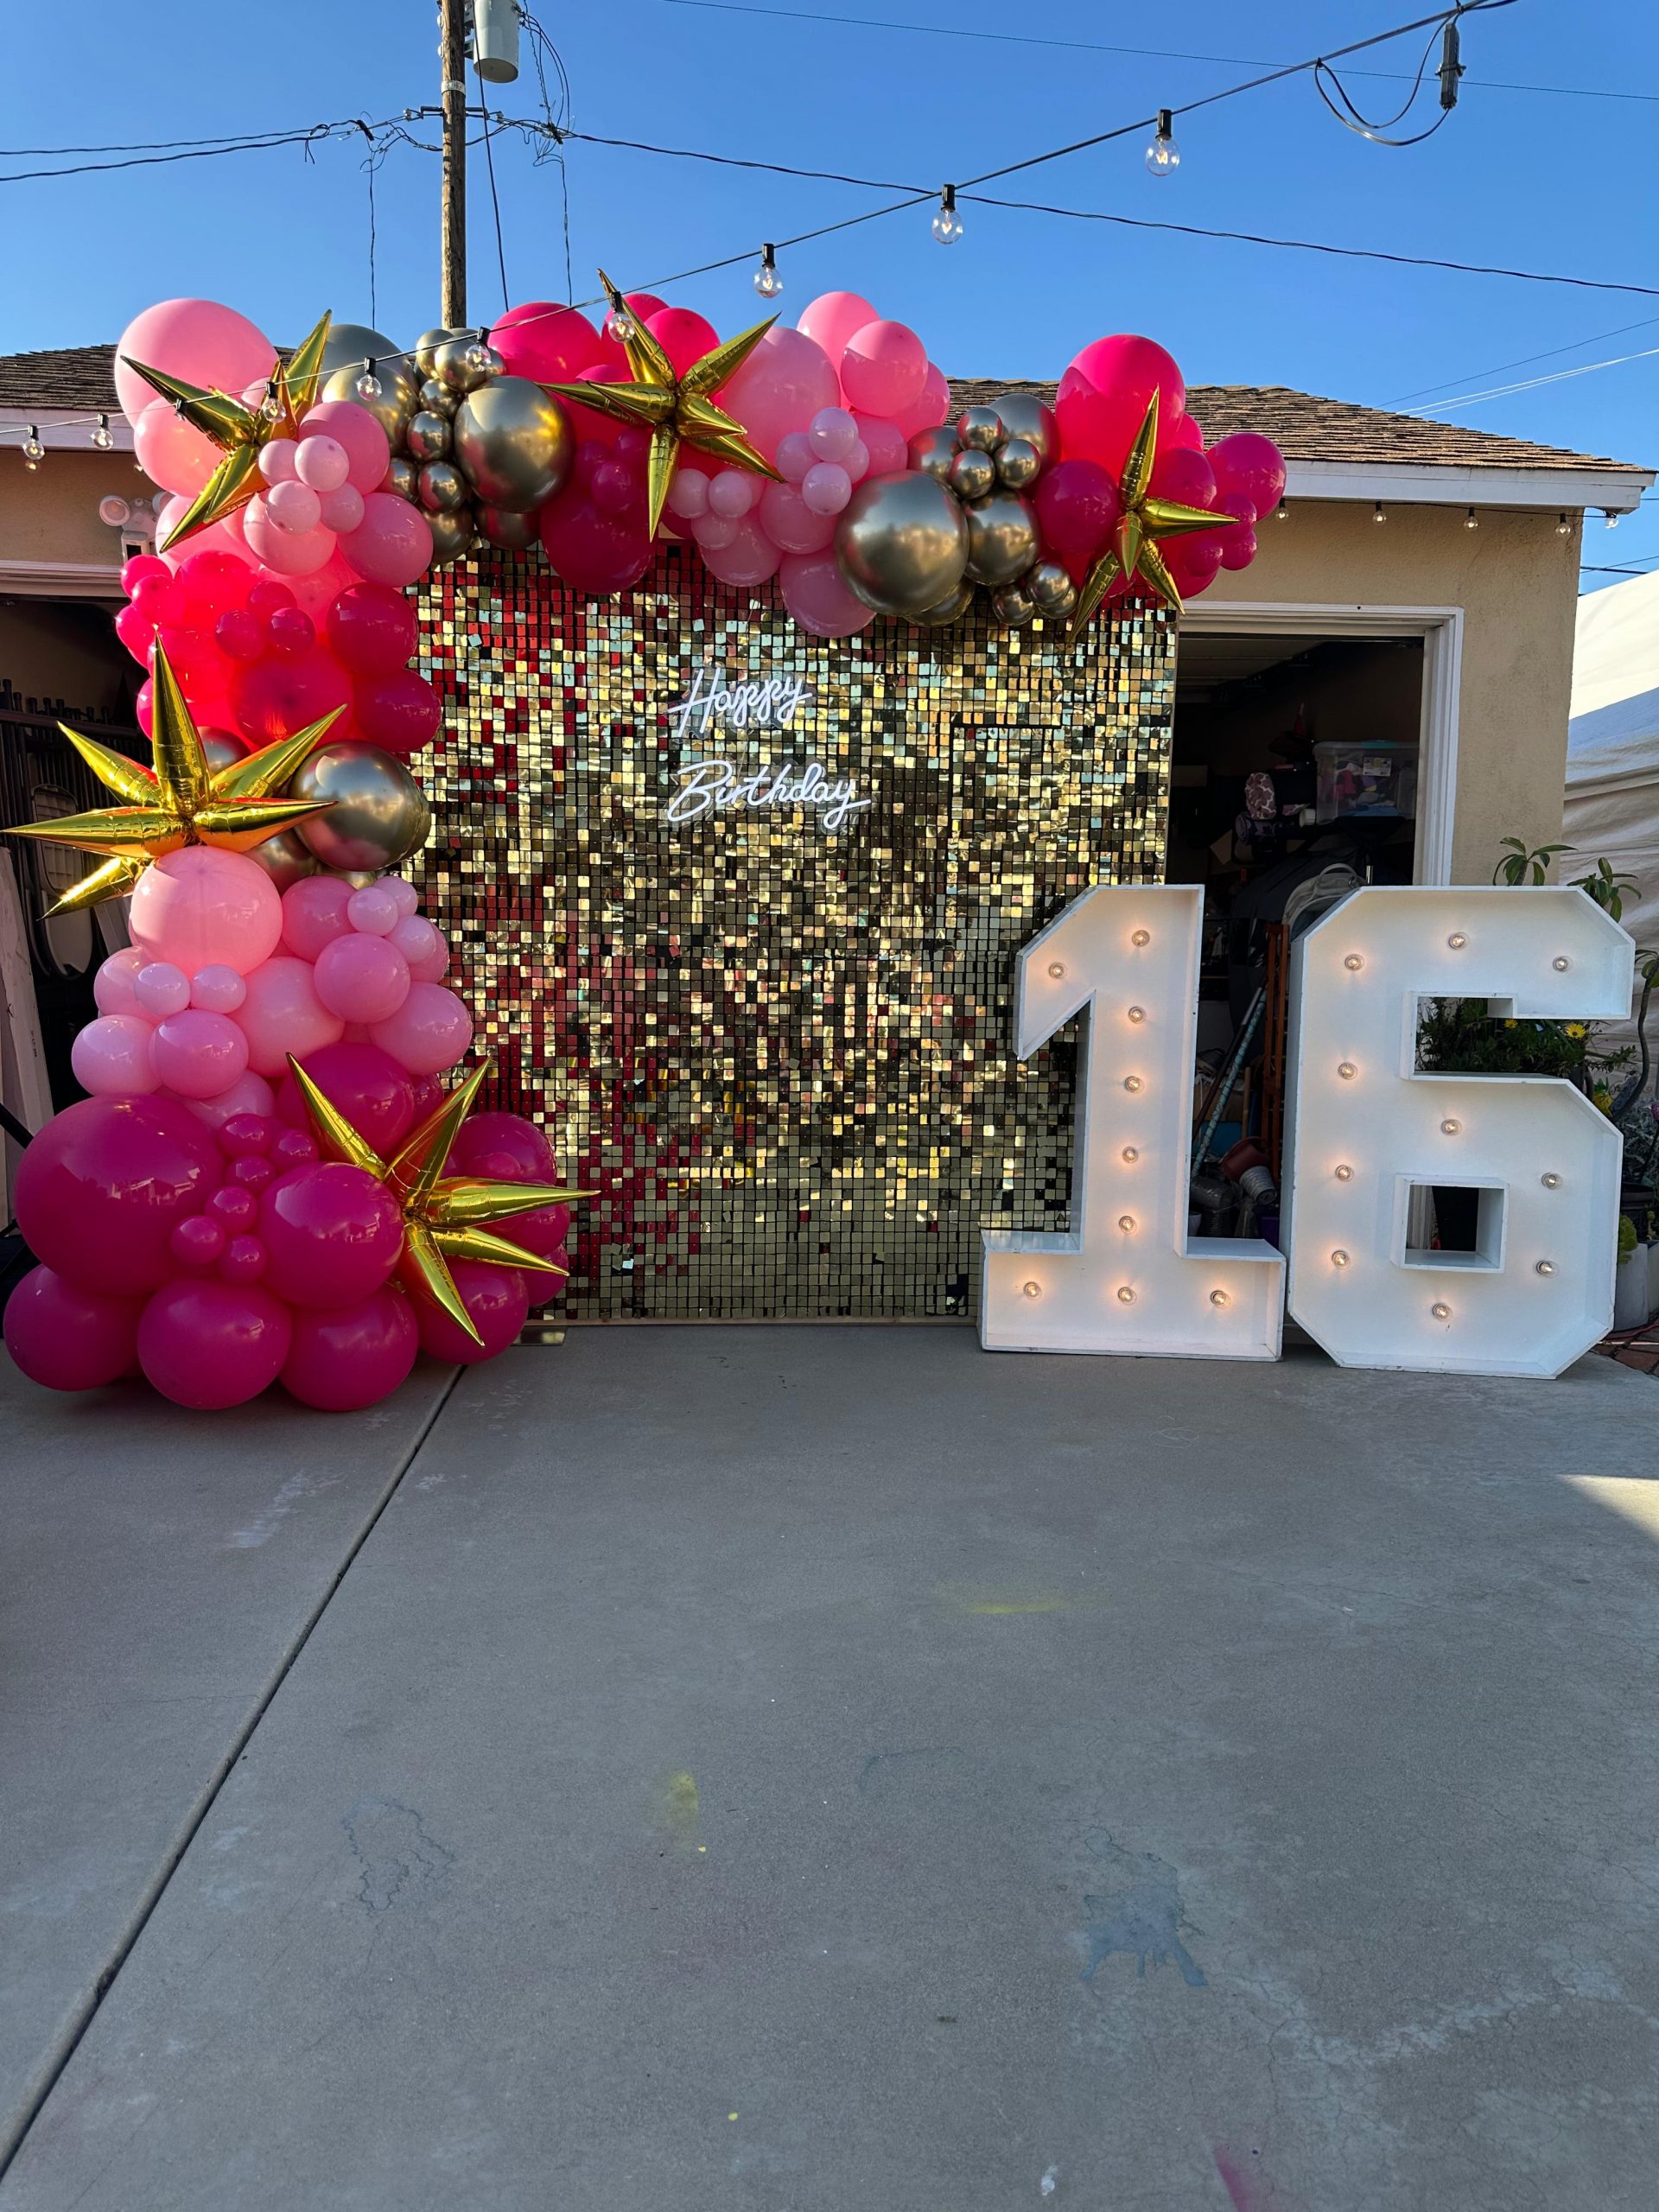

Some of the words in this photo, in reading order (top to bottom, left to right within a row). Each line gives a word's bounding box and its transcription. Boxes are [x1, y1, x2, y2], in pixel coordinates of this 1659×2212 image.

[667, 668, 813, 736] Happy
[667, 760, 871, 829] Birthday
[981, 884, 1636, 1377] 16
